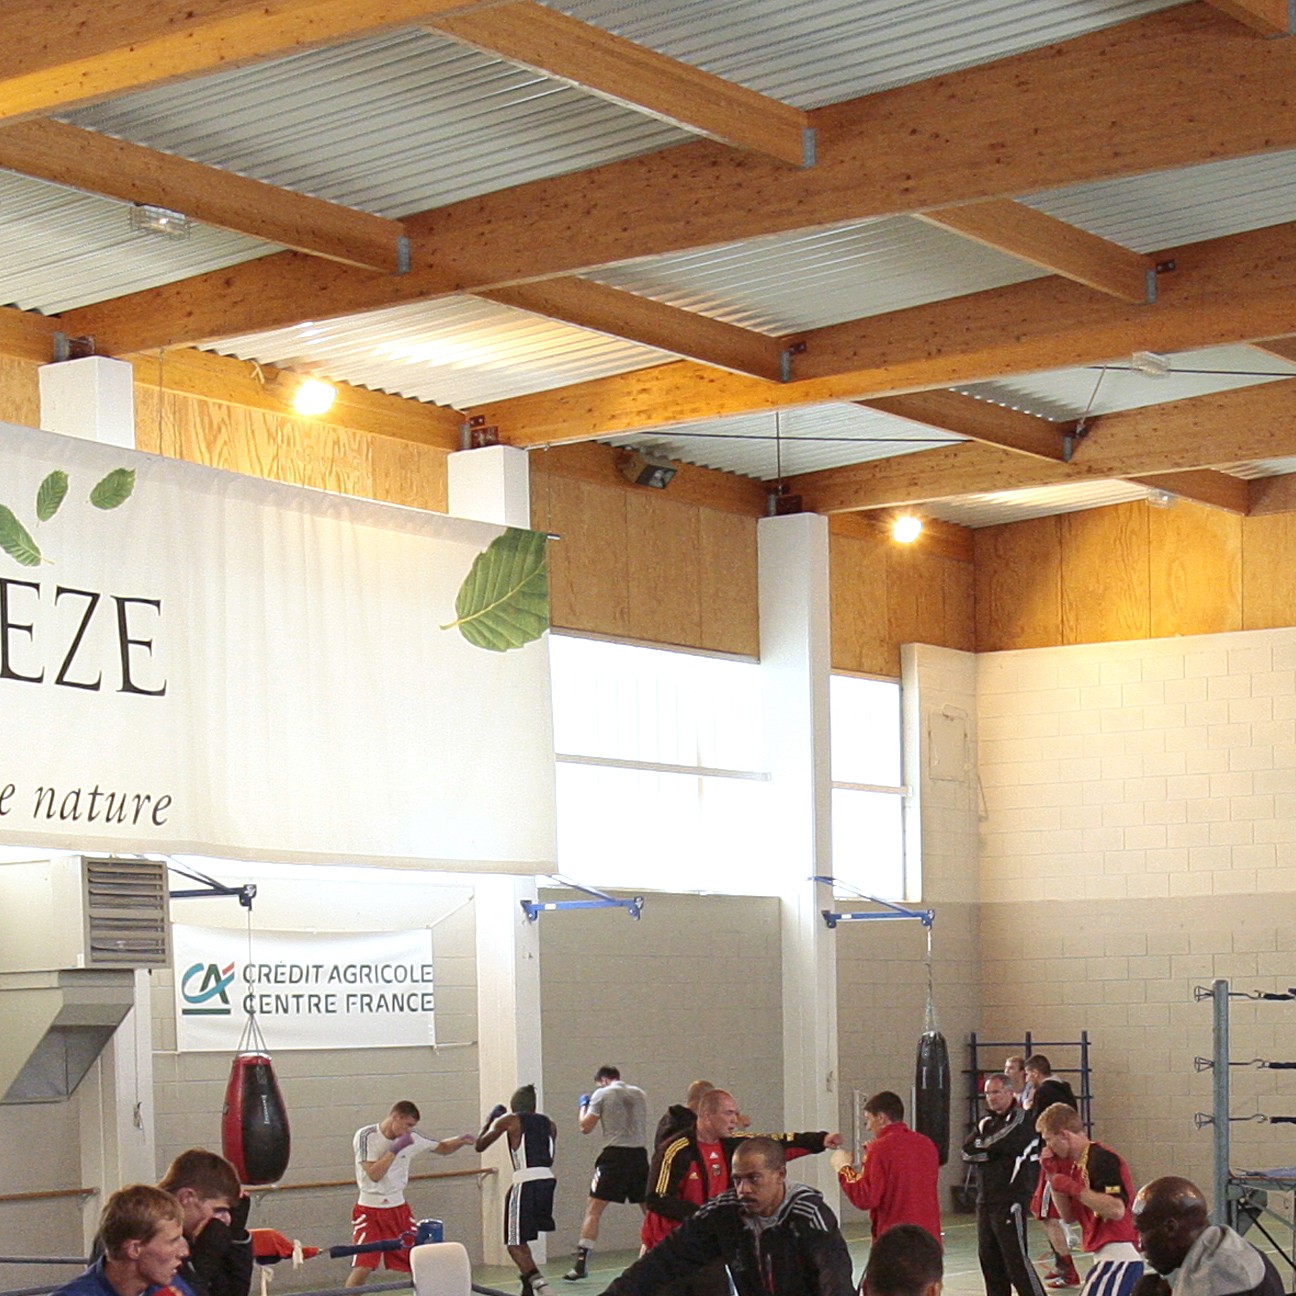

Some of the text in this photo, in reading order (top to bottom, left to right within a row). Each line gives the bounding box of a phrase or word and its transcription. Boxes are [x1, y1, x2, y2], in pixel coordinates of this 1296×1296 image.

[34, 782, 172, 827] nature
[328, 963, 433, 984] AGRICOLE
[242, 993, 435, 1014] CENTRE FRANCE
